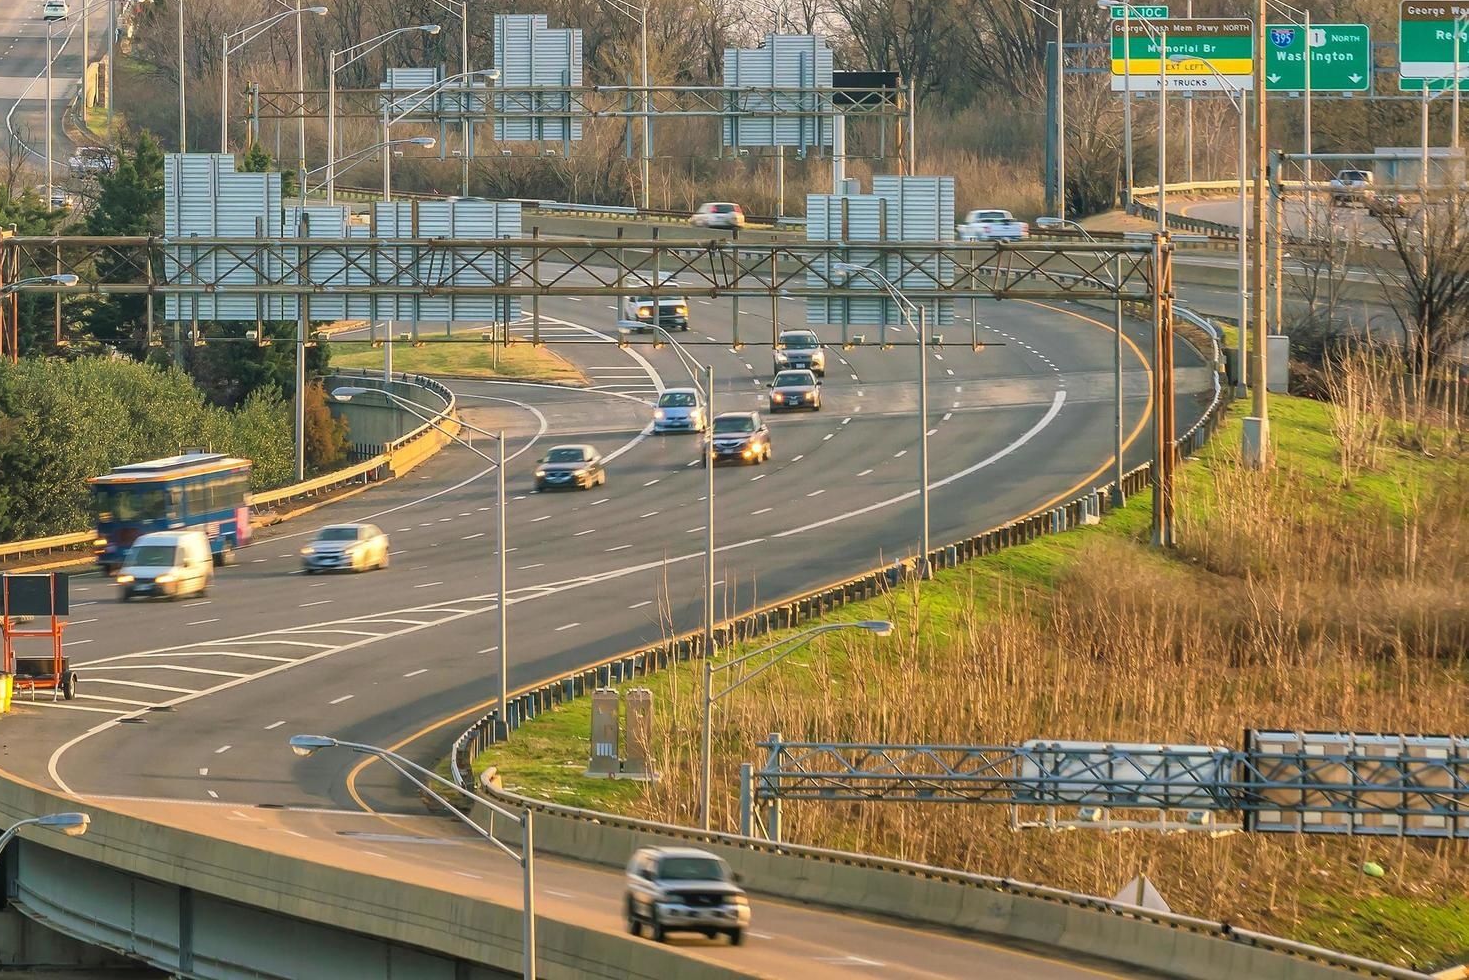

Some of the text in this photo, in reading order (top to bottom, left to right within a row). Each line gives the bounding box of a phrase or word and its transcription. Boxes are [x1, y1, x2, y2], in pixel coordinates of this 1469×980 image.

[1141, 8, 1162, 17] 10C
[1408, 6, 1446, 18] George
[1196, 24, 1220, 33] Pkwy
[1275, 33, 1292, 44] 395
[1314, 32, 1319, 43] 1
[1436, 30, 1468, 43] Reg
[1203, 44, 1216, 53] Br
